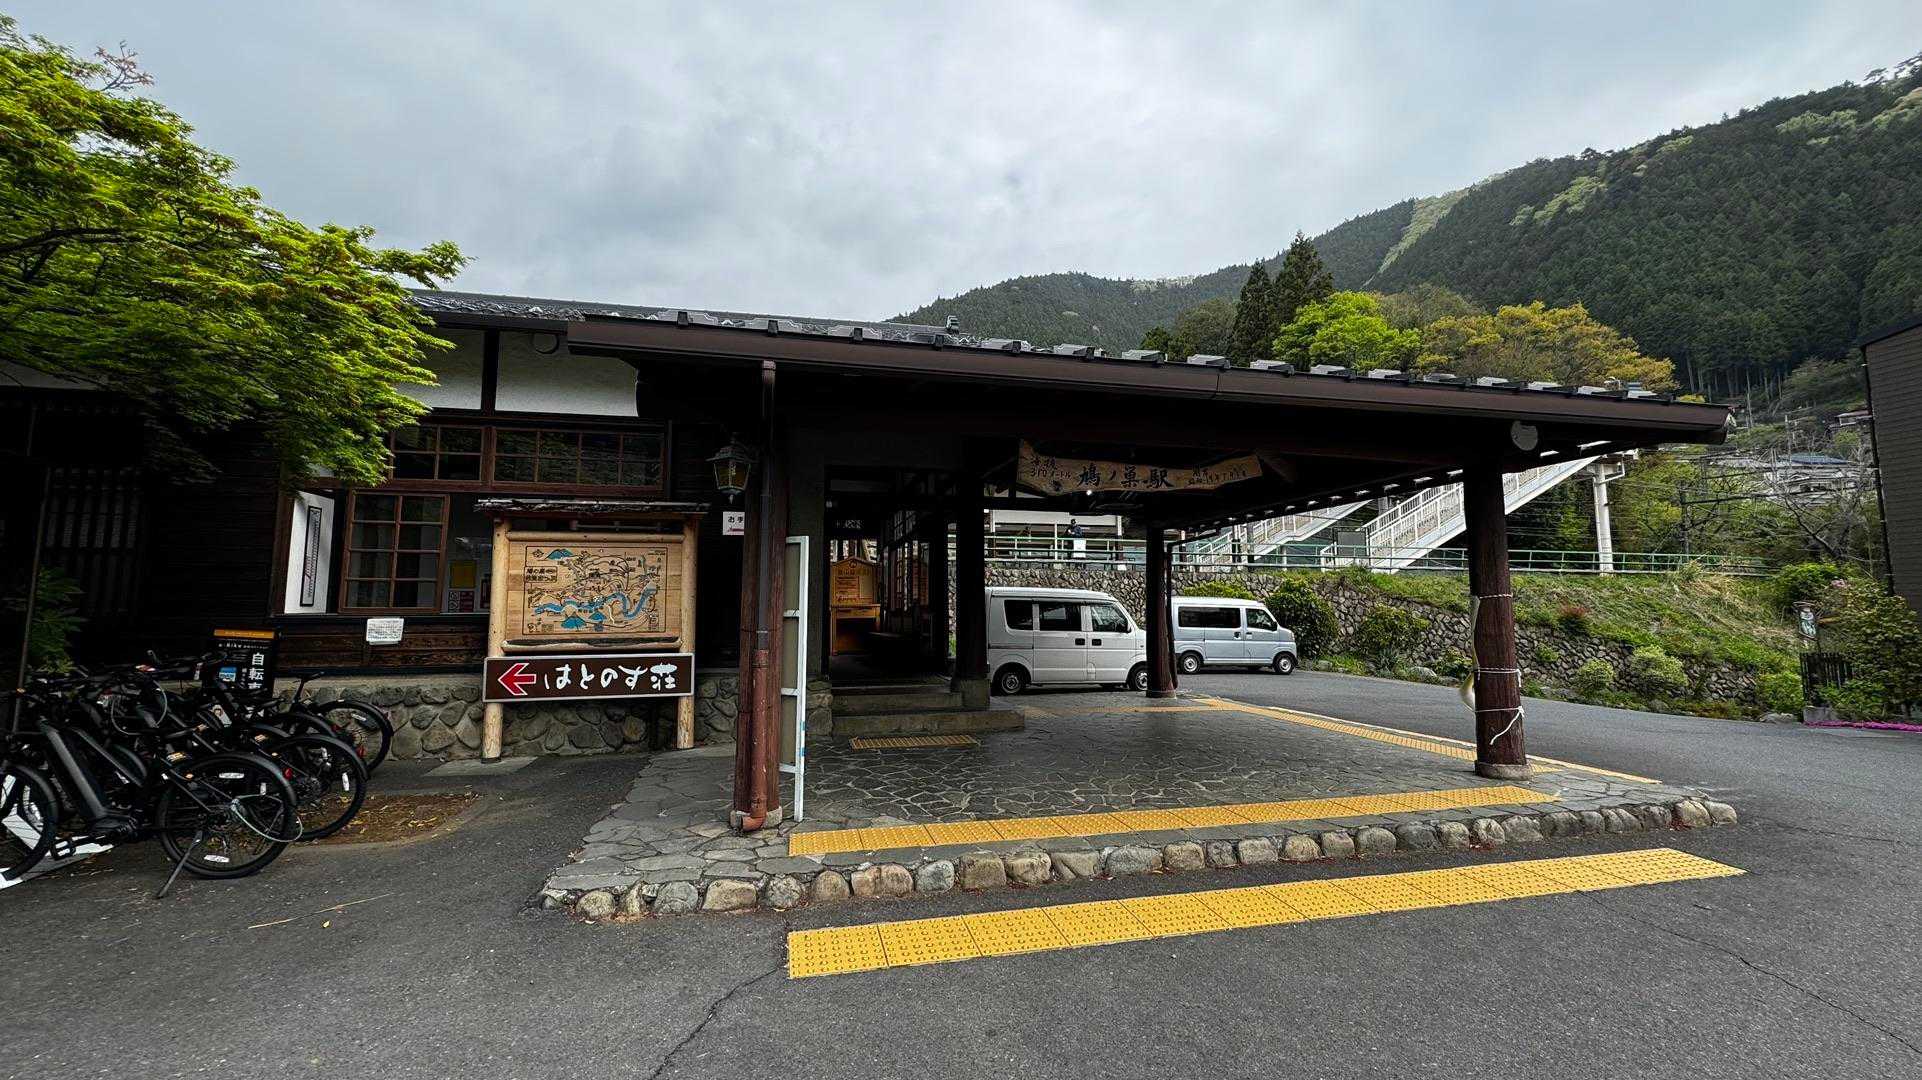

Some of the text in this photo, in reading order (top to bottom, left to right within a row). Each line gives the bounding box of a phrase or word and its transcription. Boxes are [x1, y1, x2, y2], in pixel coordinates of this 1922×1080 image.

[1078, 462, 1173, 489] 鳩ノ巣駅
[544, 662, 678, 691] はとのす荘
